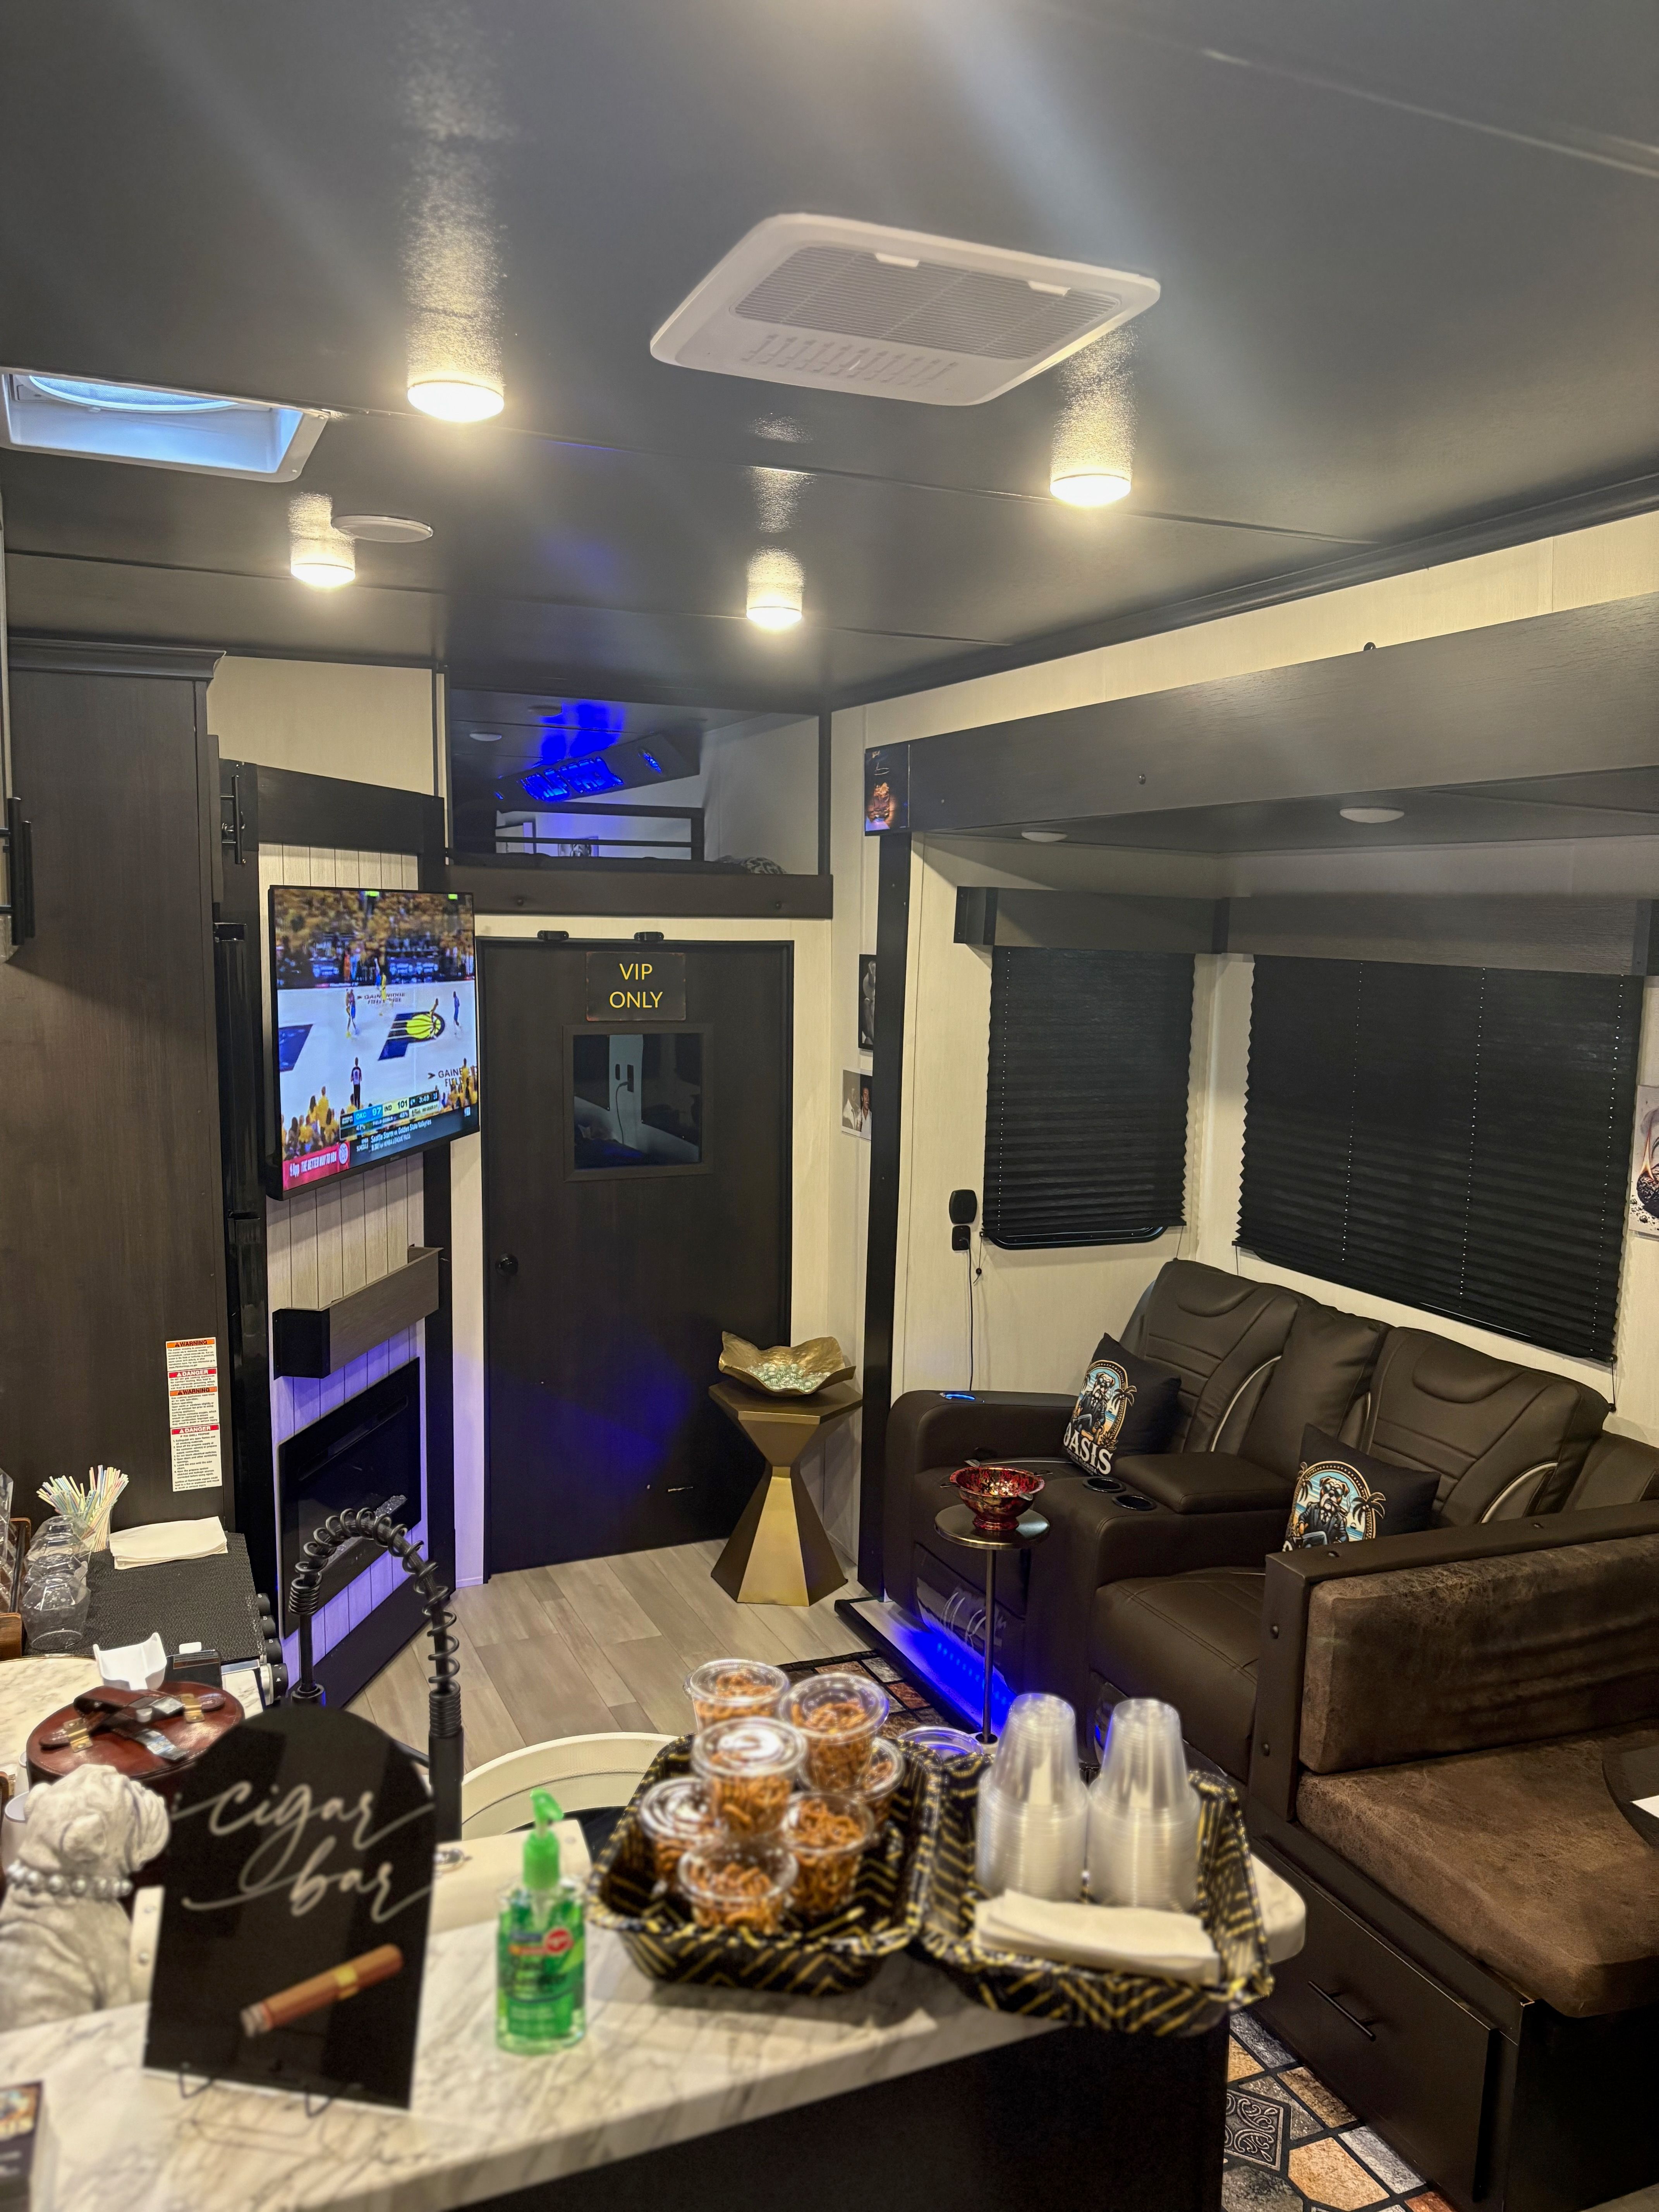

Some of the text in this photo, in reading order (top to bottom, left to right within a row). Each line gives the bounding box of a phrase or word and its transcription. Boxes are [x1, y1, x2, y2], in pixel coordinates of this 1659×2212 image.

[619, 963, 653, 980] VIP
[609, 991, 663, 1008] ONLY
[356, 1112, 367, 1120] OKC
[372, 1106, 382, 1116] 97
[398, 1099, 407, 1109] 101
[383, 1131, 394, 1139] Storm
[1063, 1422, 1113, 1475] OASIS
[171, 1781, 434, 1893] cigar
